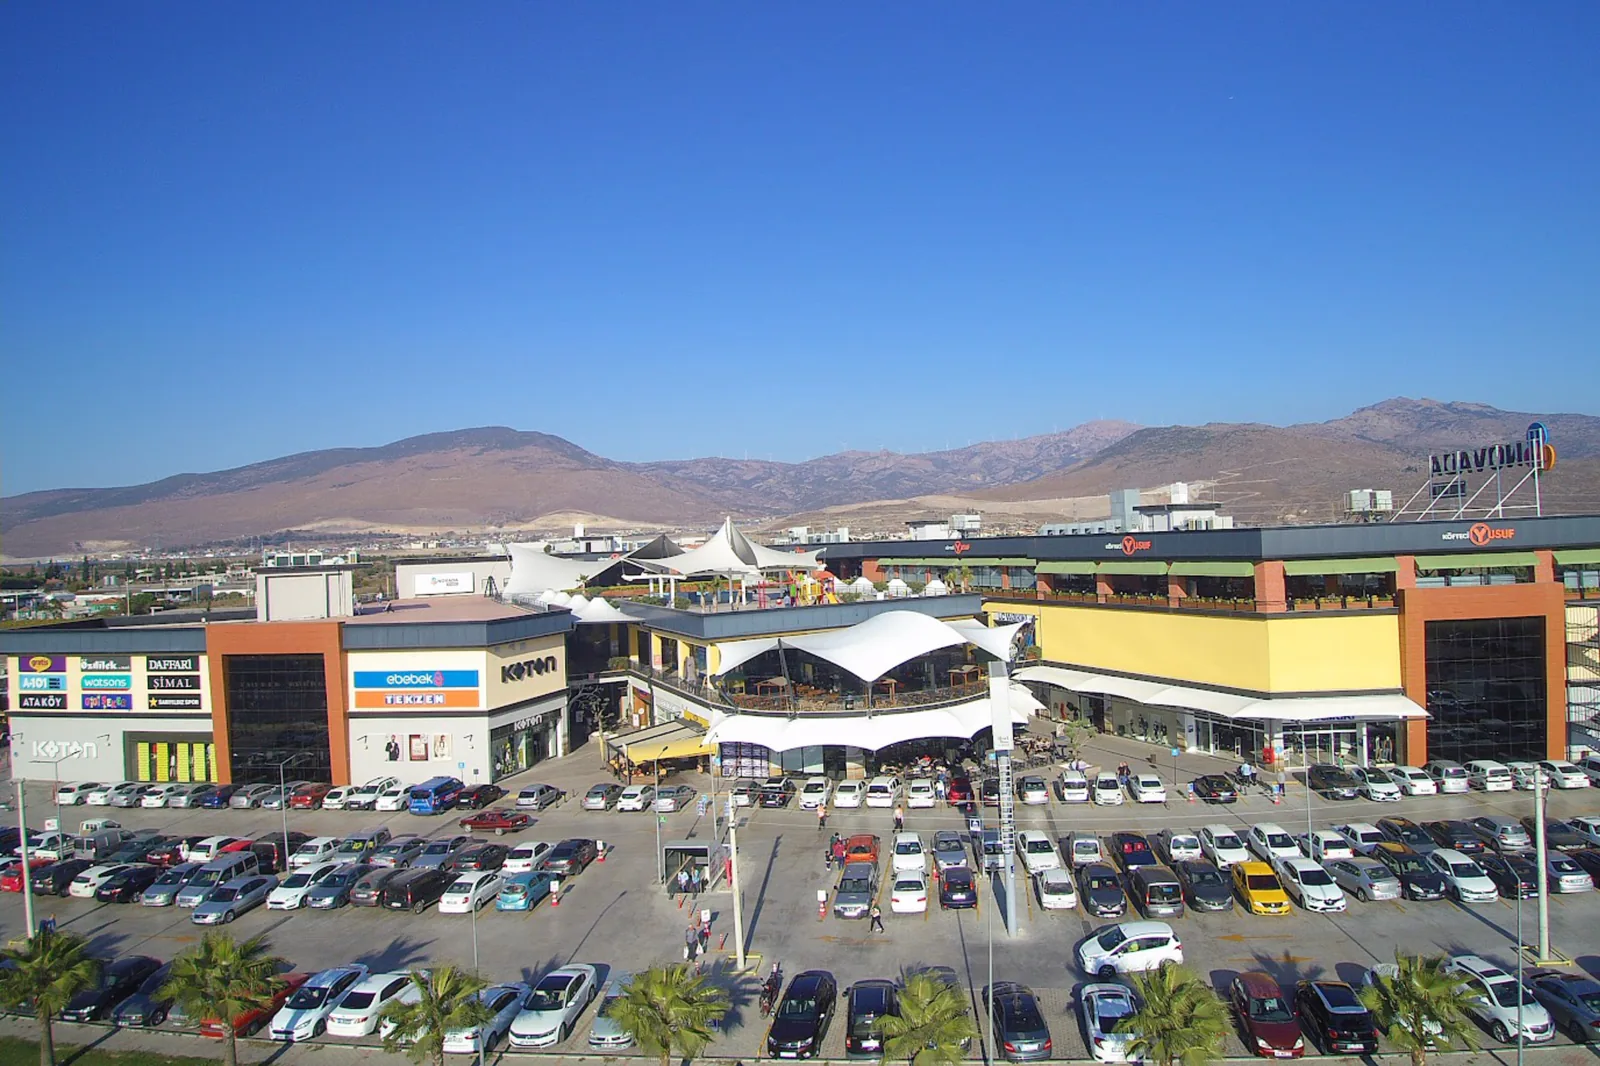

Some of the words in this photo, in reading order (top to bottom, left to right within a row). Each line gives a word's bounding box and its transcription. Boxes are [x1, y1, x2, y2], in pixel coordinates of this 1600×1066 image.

[1470, 522, 1515, 546] YUSUF
[501, 656, 557, 684] KOTON
[84, 679, 127, 687] watsons
[153, 676, 193, 690] ŞİMAL
[386, 673, 433, 685] ebebek
[22, 695, 62, 707] ATAKÖY
[385, 694, 445, 705] TEKZEN
[514, 715, 543, 731] KOTON
[32, 741, 98, 759] KOTON
